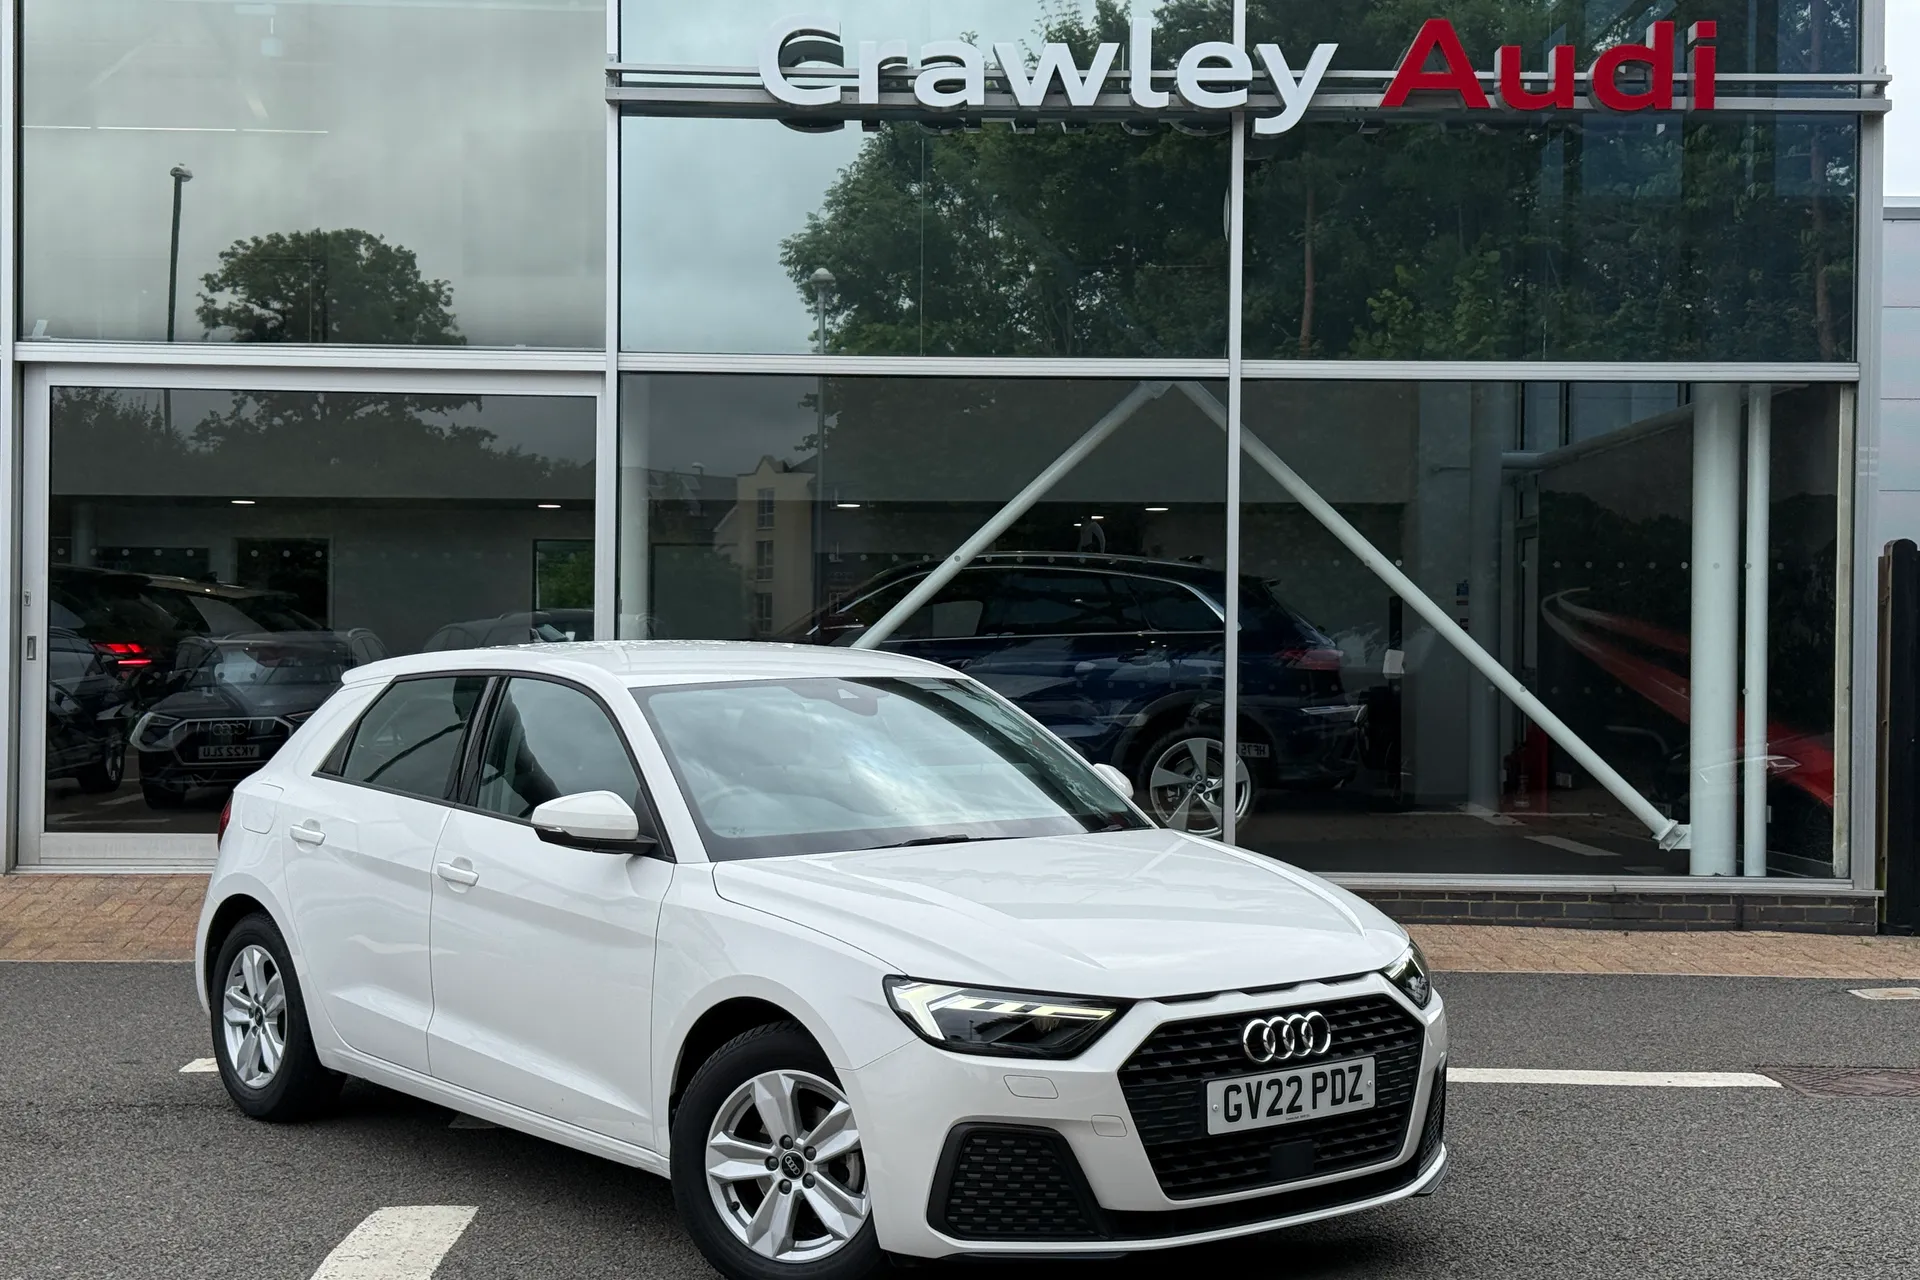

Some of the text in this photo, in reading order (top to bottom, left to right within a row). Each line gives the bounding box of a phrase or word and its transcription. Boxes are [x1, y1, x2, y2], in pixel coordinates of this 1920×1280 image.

[758, 14, 1717, 137] Crawley Audi
[1223, 1064, 1364, 1123] GV22 PDZ
